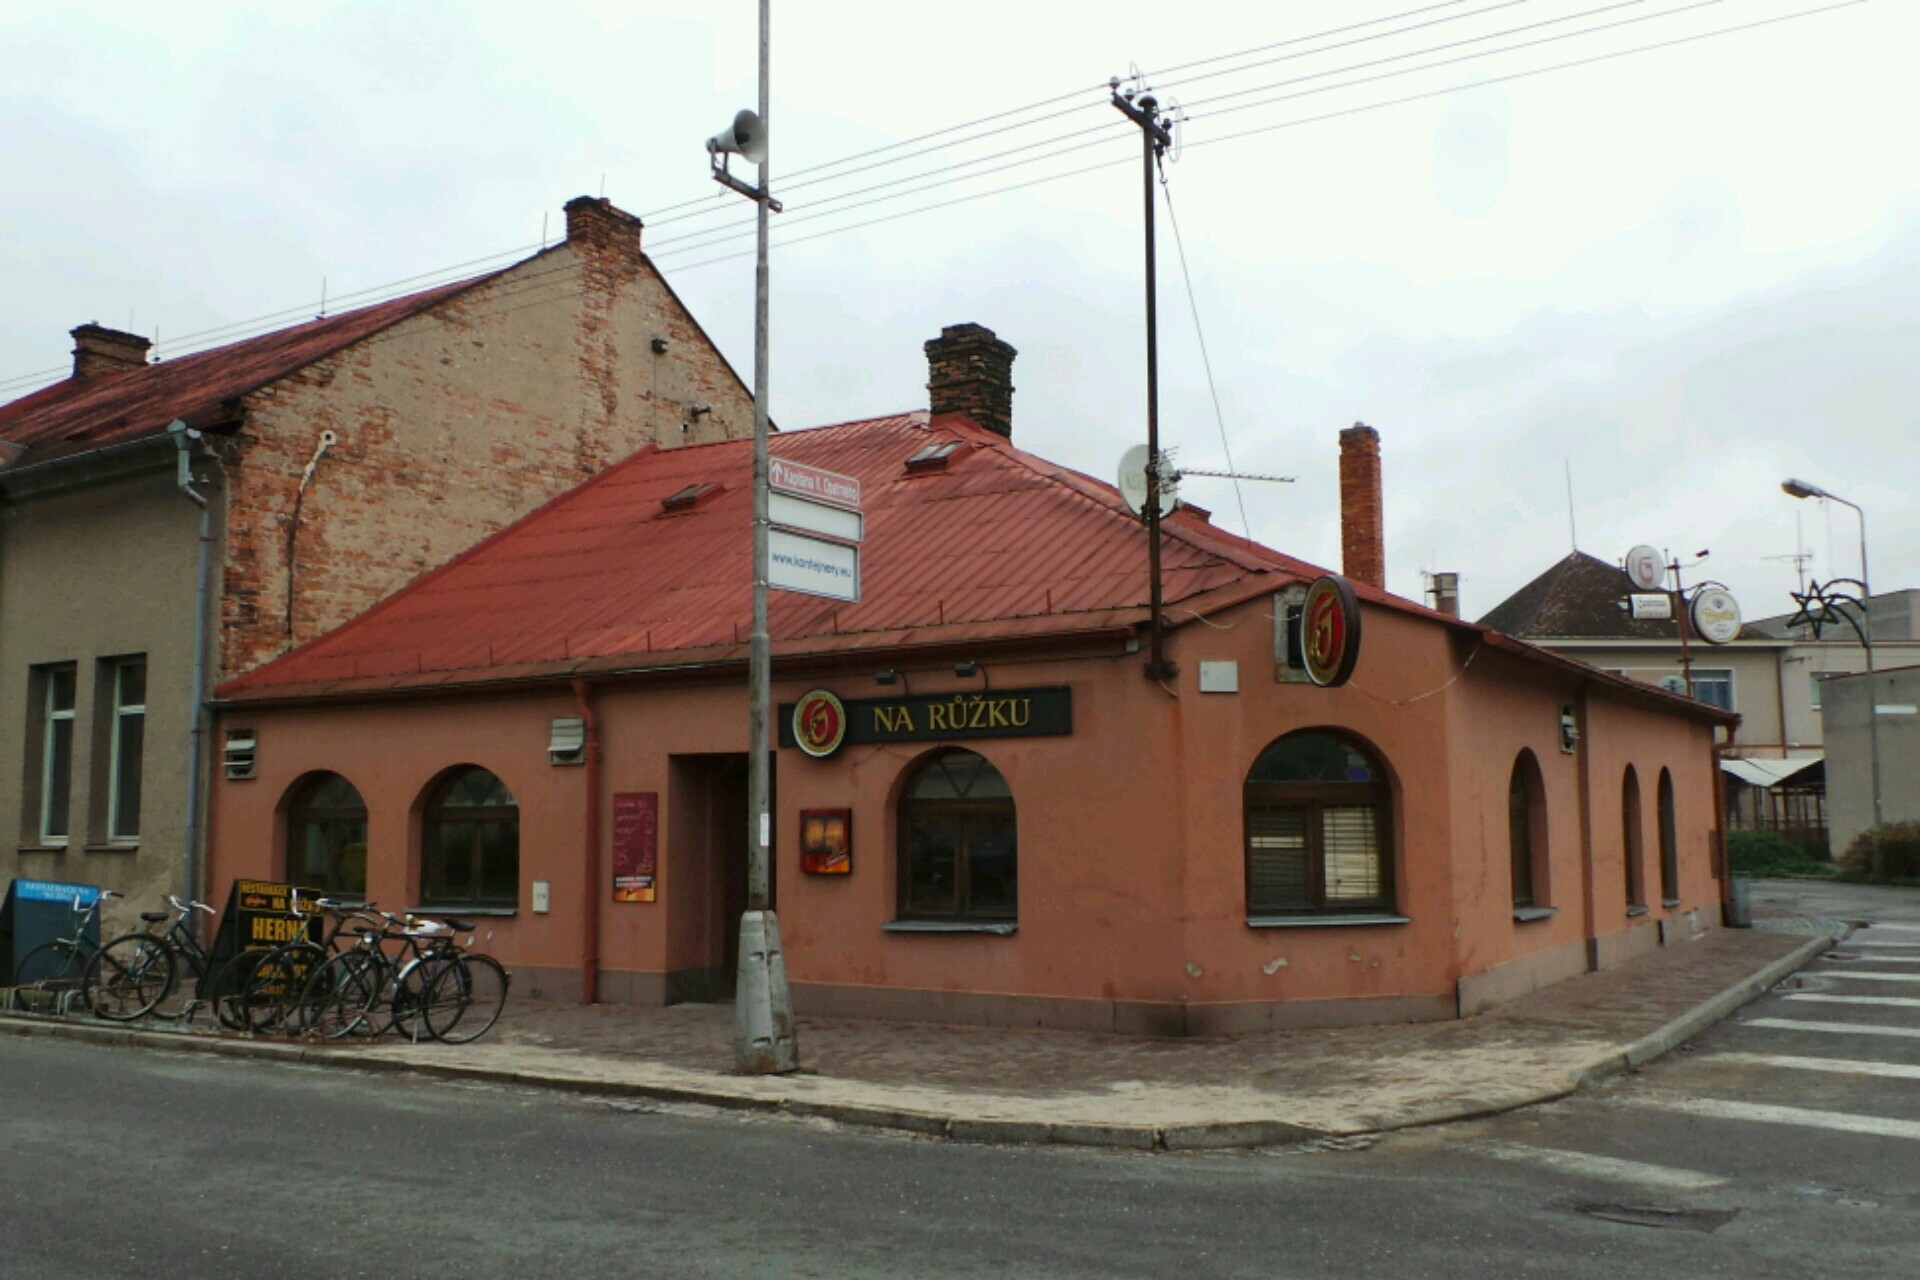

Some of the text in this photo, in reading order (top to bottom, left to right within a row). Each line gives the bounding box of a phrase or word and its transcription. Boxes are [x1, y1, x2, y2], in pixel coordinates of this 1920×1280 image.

[873, 695, 1031, 732] NA RŮŽKU
[252, 917, 309, 942] HERNA
